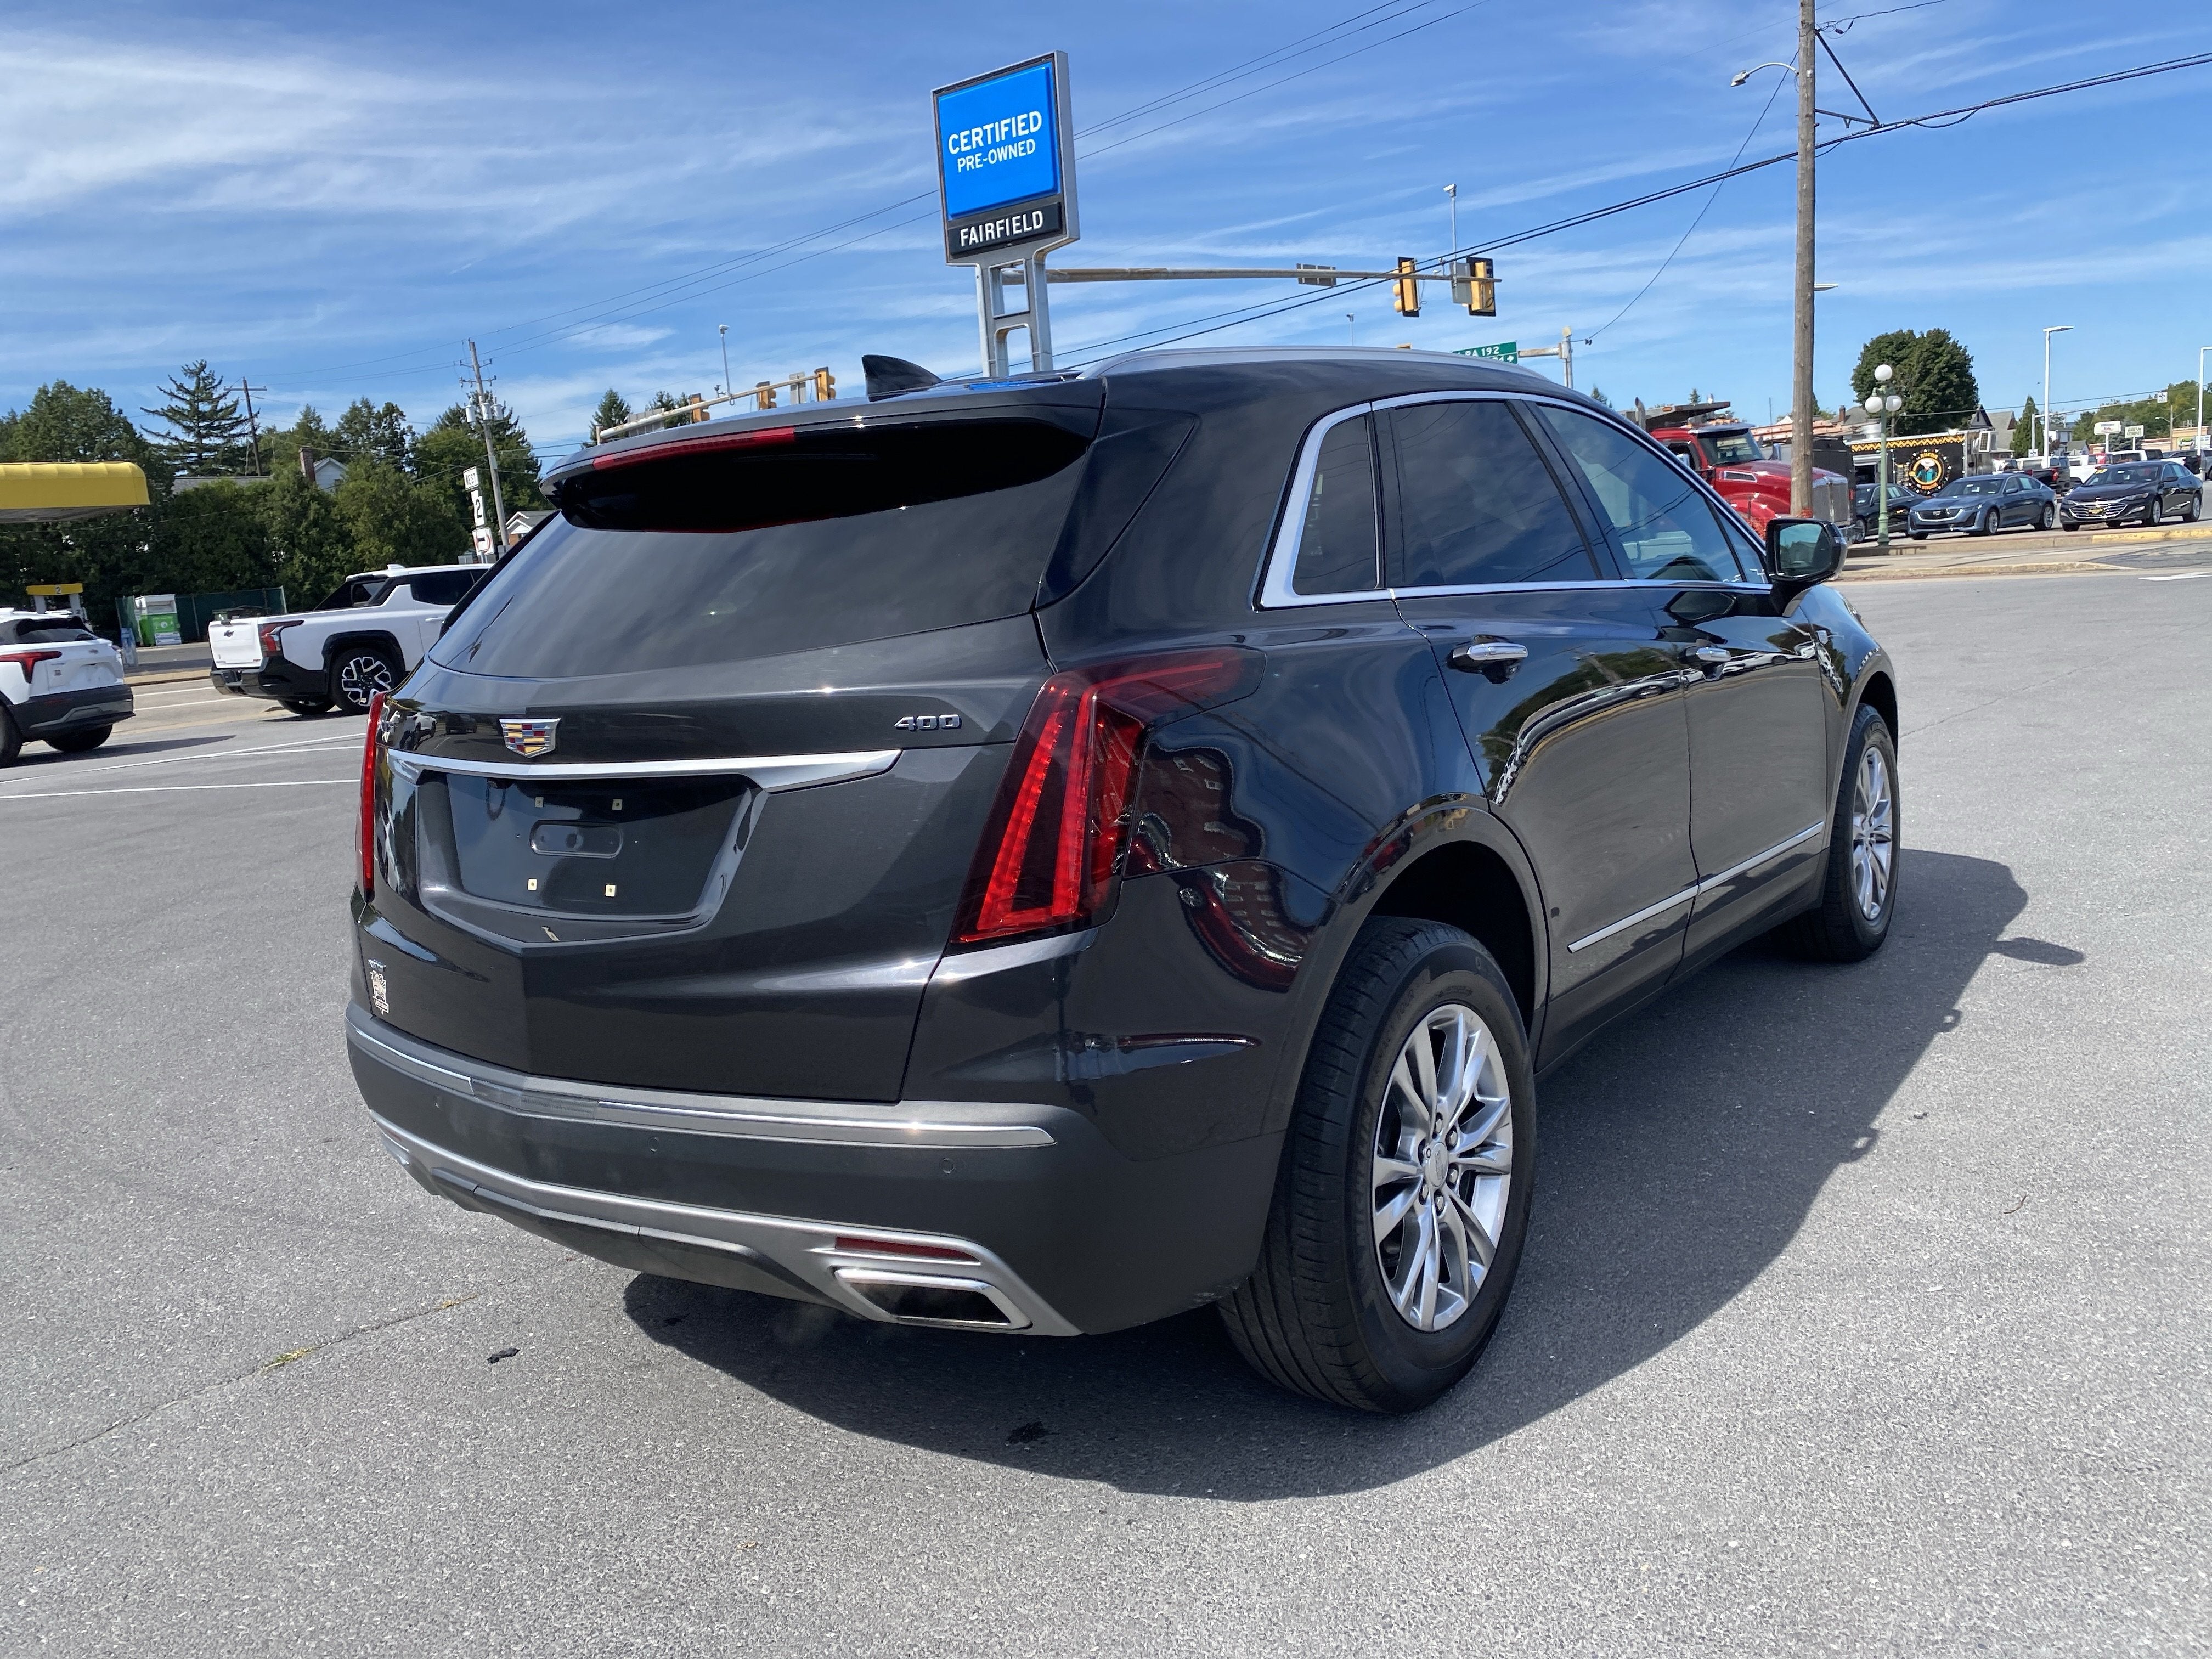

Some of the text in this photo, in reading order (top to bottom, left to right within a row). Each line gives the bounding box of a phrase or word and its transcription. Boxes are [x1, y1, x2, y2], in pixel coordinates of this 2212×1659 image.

[948, 111, 1042, 155] CERTIFIED
[957, 139, 1036, 173] PRE-OWNED
[960, 210, 1043, 247] FAIRFIELD
[1481, 346, 1500, 356] 192
[465, 473, 476, 486] WEST
[894, 714, 960, 730] 400
